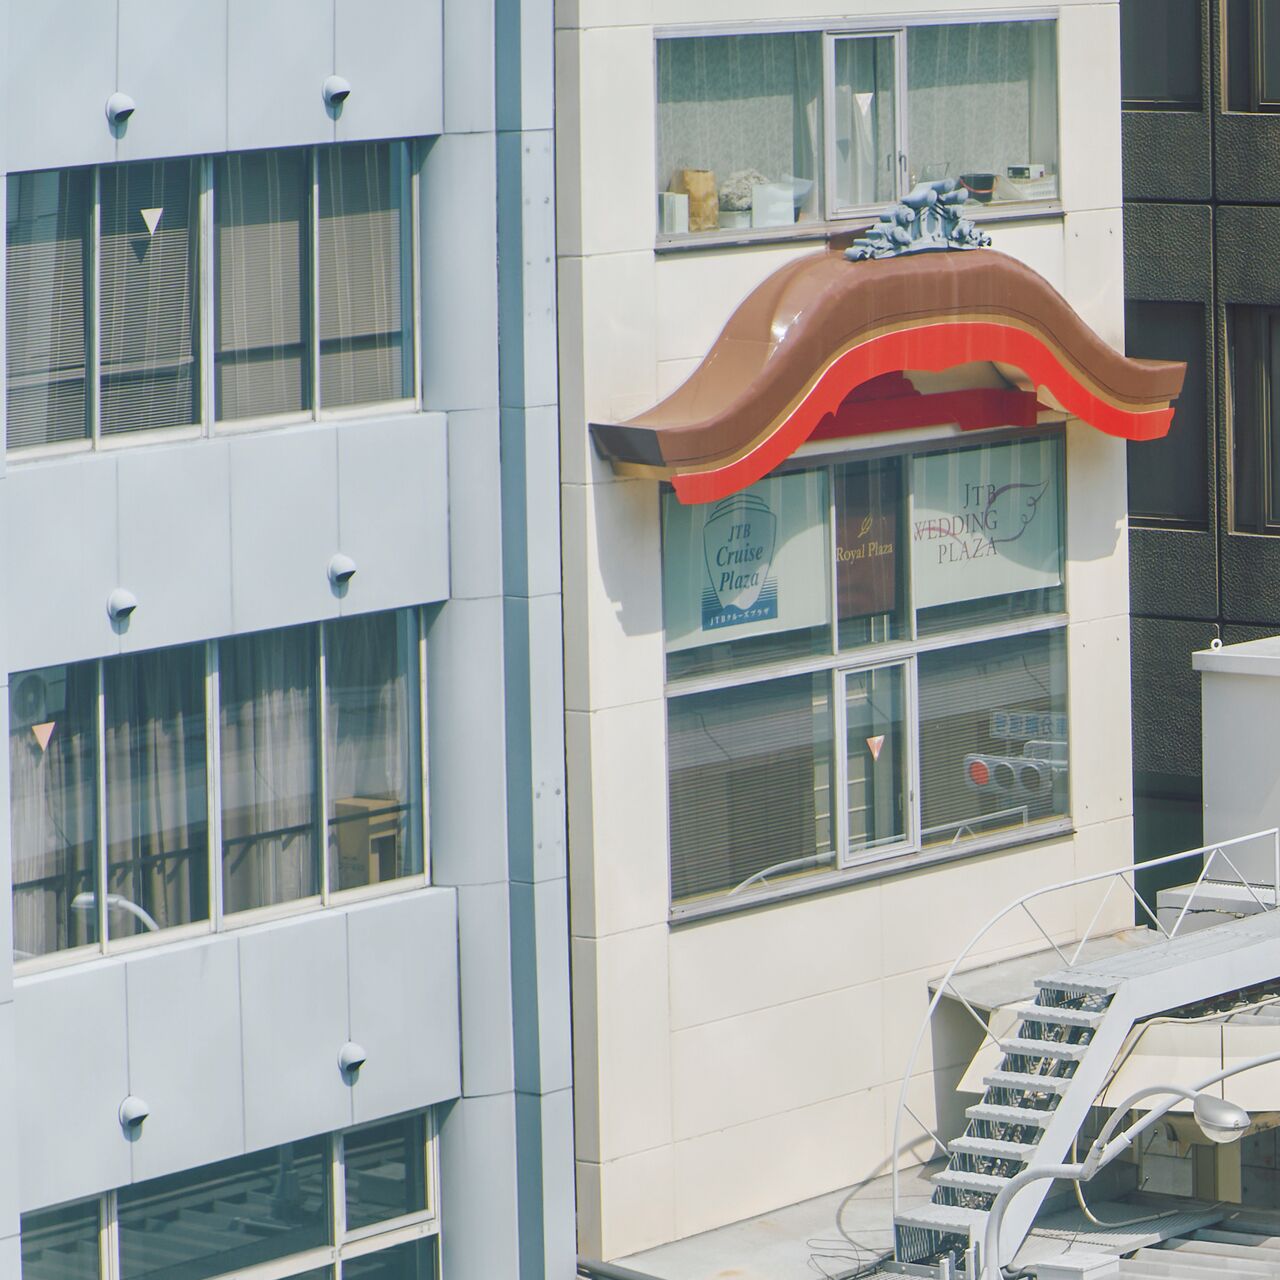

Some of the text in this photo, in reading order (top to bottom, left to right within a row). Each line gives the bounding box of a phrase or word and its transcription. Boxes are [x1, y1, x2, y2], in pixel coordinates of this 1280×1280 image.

[963, 483, 997, 509] JTB
[728, 523, 751, 543] JTB
[914, 509, 998, 541] WEDDING
[716, 543, 763, 567] Cruise
[836, 541, 893, 566] Royal Plaza
[938, 536, 998, 564] PLAZA
[719, 570, 760, 592] Plaza
